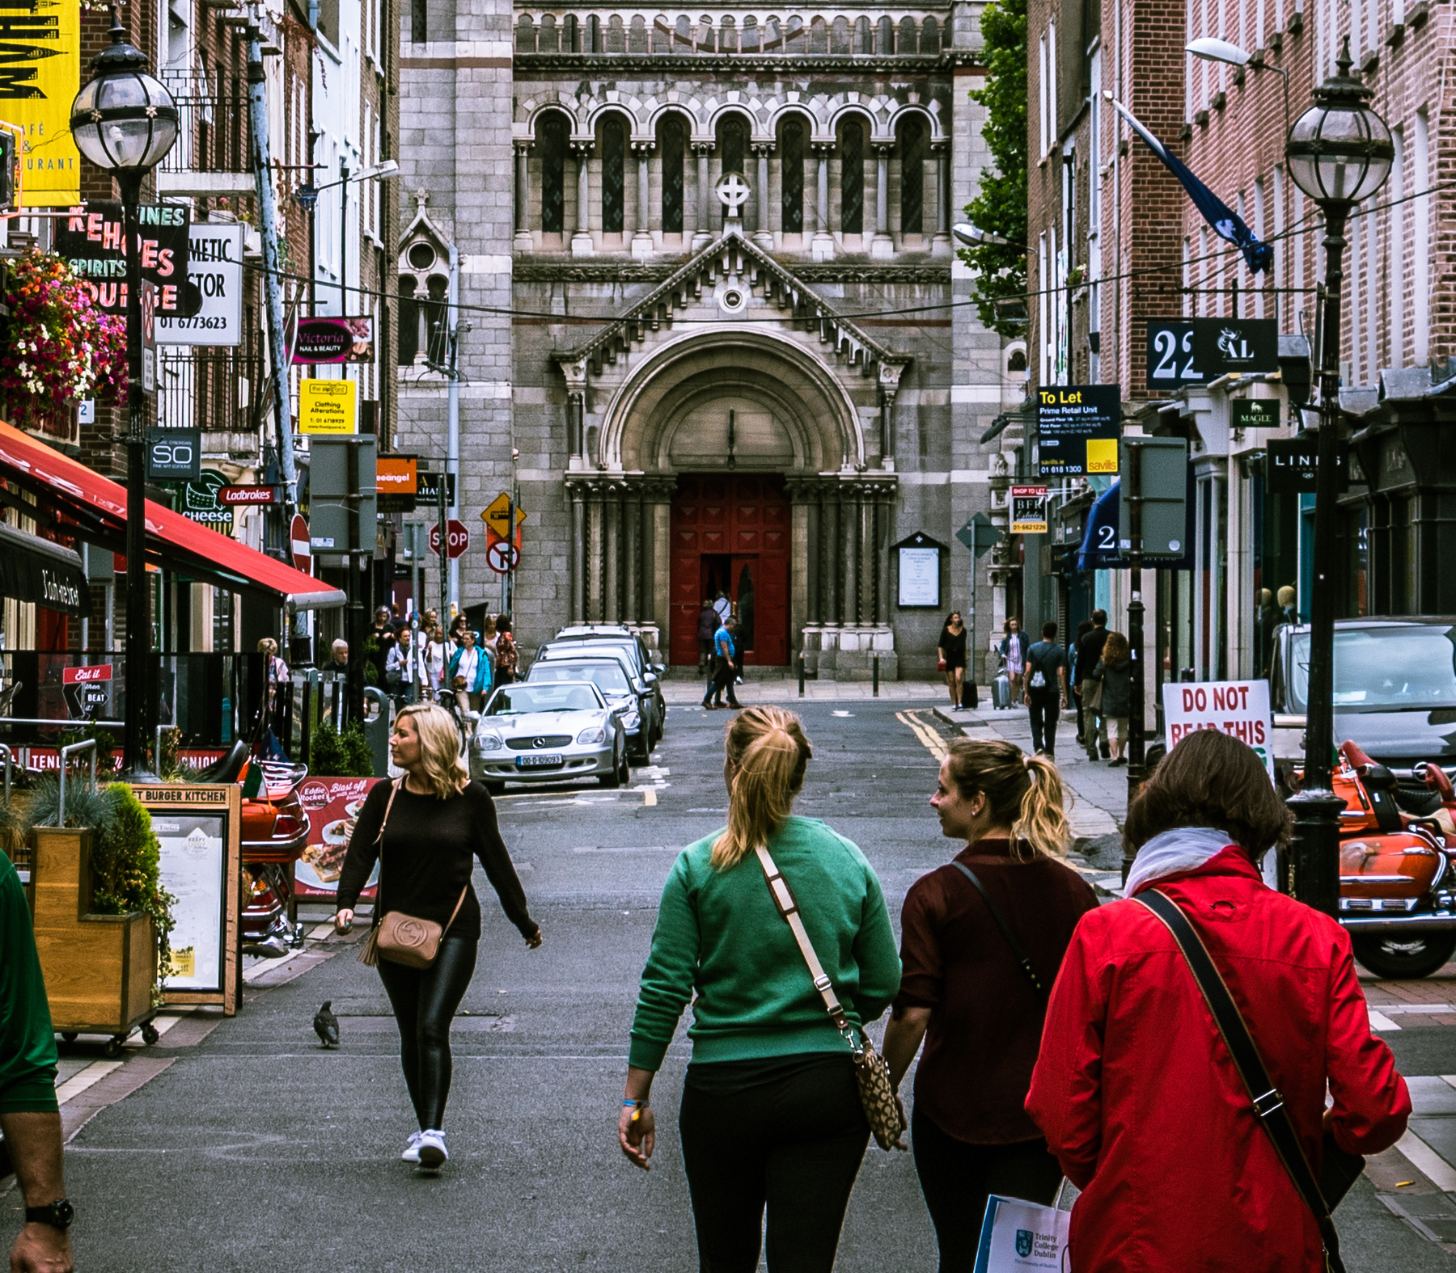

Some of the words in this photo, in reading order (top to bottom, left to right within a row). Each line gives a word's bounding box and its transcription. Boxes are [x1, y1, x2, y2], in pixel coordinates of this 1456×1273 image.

[189, 238, 232, 263] METIC
[69, 258, 127, 278] SPIRITS
[298, 332, 344, 344] Victoria
[1153, 330, 1204, 379] 22
[1039, 391, 1056, 404] To
[1060, 391, 1082, 404] Let
[315, 401, 341, 410] Clothing
[1039, 407, 1060, 415] Prime
[1062, 407, 1082, 415] Retail
[1083, 406, 1098, 414] Unit
[1240, 414, 1272, 423] MAGEE
[153, 445, 193, 464] SO
[1088, 460, 1117, 471] savills
[1275, 455, 1341, 466] LINS
[1065, 465, 1082, 473] 1300
[226, 490, 271, 501] Ladbrokes
[432, 532, 468, 546] SOP
[75, 669, 91, 681] Eat
[92, 668, 100, 679] it
[87, 693, 105, 703] BEAT
[1182, 688, 1207, 712] DO
[1213, 686, 1249, 711] NOT
[1171, 723, 1218, 748] RE
[1223, 720, 1266, 745] THIS
[353, 779, 367, 791] off
[146, 790, 182, 801] BURGER
[185, 791, 226, 802] KITCHEN
[304, 787, 325, 795] Eddie
[1035, 1233, 1058, 1243] Trinity
[1034, 1241, 1059, 1250] College
[1034, 1249, 1057, 1259] Dublin
